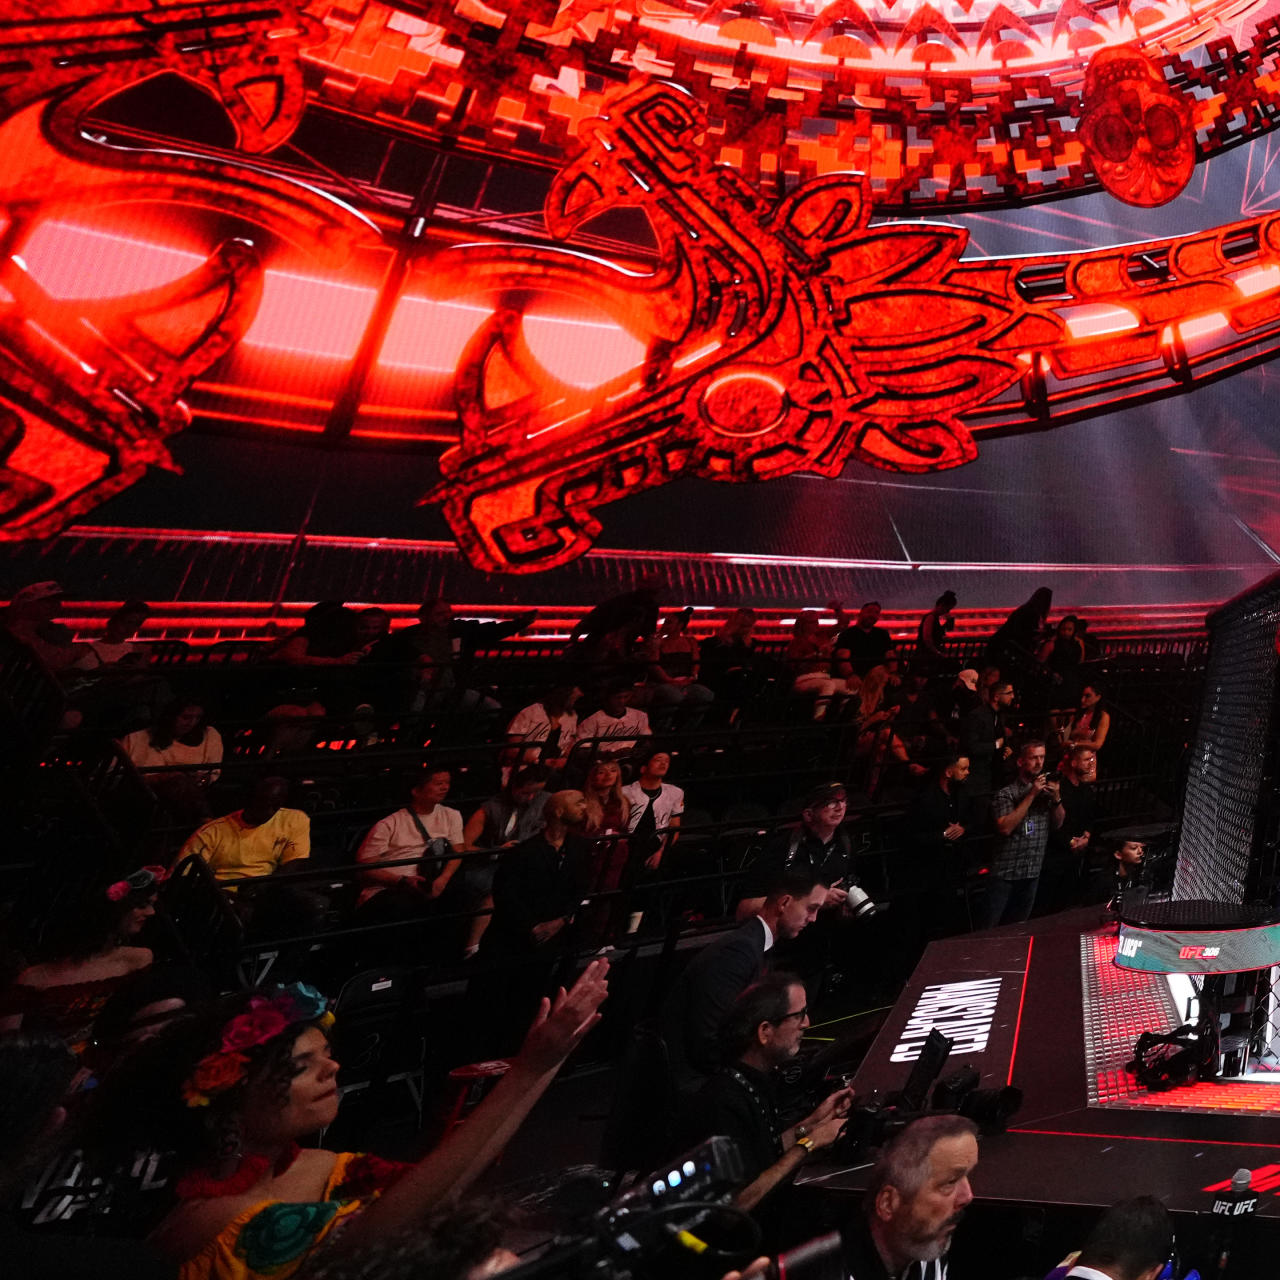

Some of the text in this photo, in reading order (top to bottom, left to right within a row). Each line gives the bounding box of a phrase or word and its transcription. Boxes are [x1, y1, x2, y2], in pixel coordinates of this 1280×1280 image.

[1179, 946, 1220, 960] UFC 306
[1213, 1198, 1257, 1216] UFC UFC
